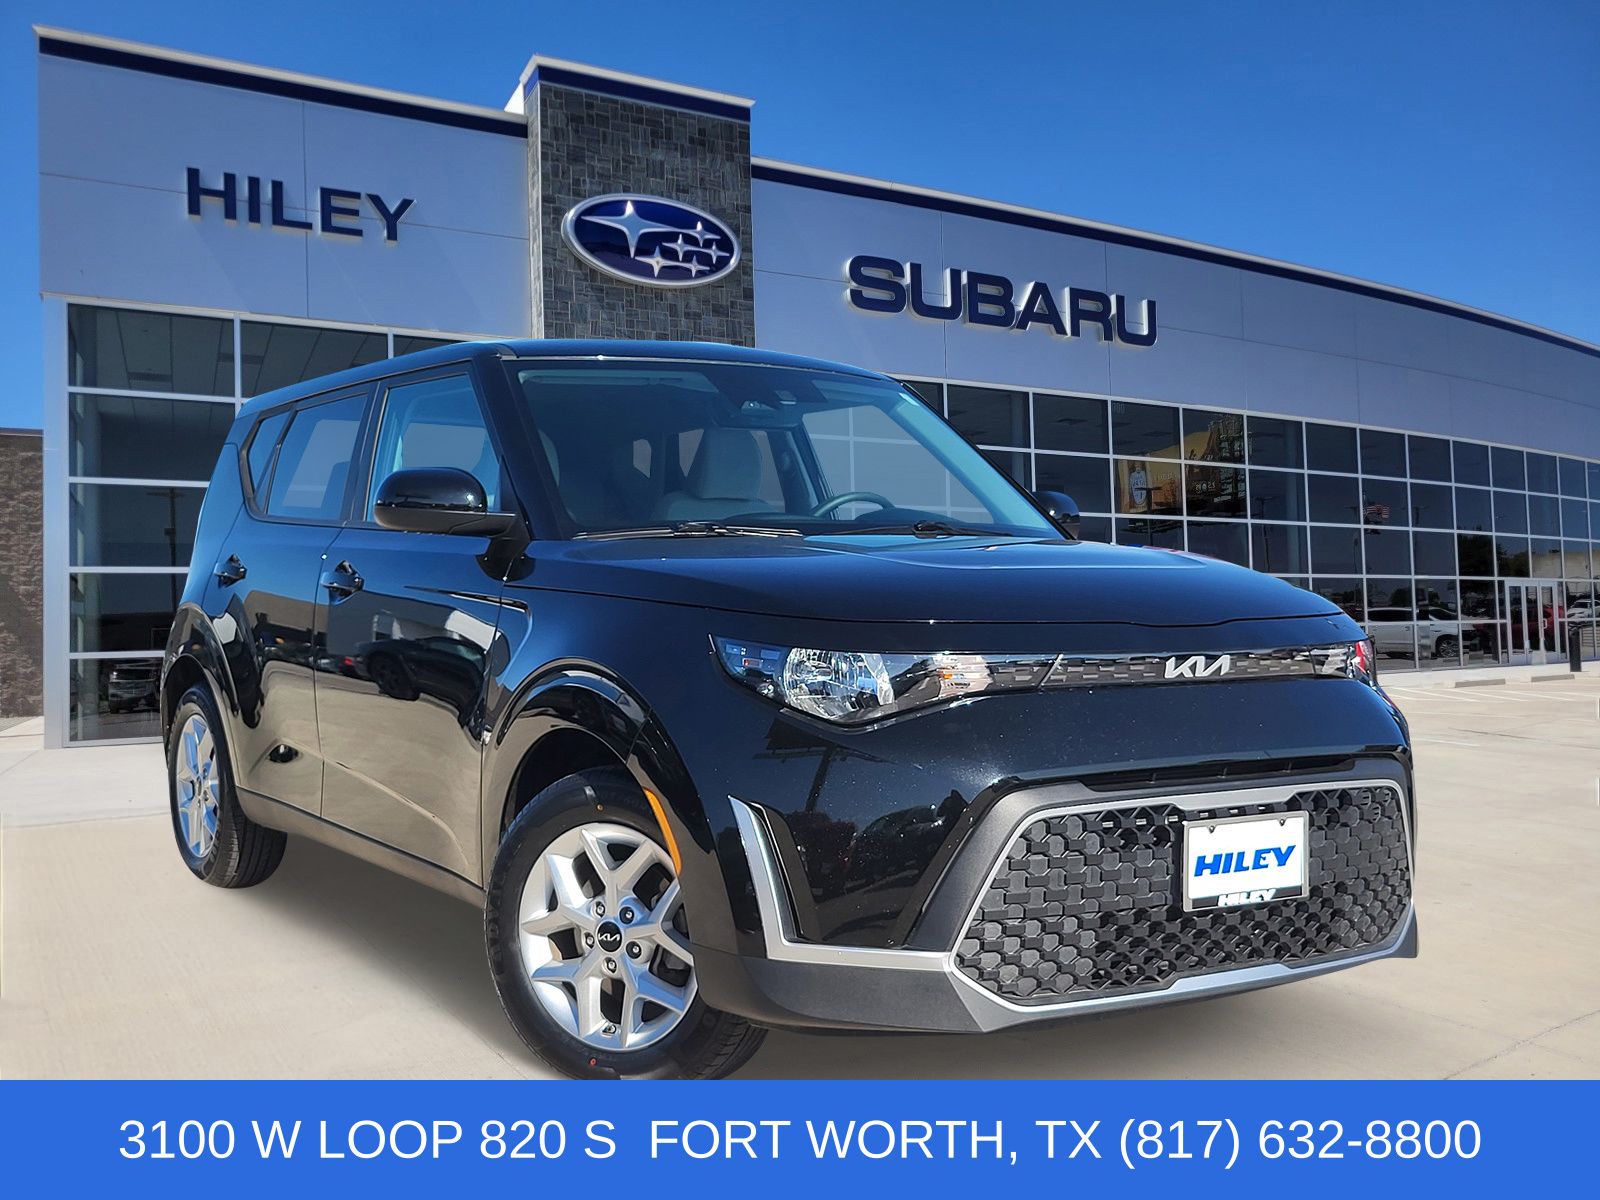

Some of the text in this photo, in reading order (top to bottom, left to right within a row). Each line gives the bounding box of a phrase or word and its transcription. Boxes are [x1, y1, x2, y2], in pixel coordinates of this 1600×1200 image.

[186, 166, 415, 242] HILEY
[848, 254, 1158, 347] SUBARU
[1194, 845, 1297, 877] HILEY
[1217, 888, 1277, 908] HILEY
